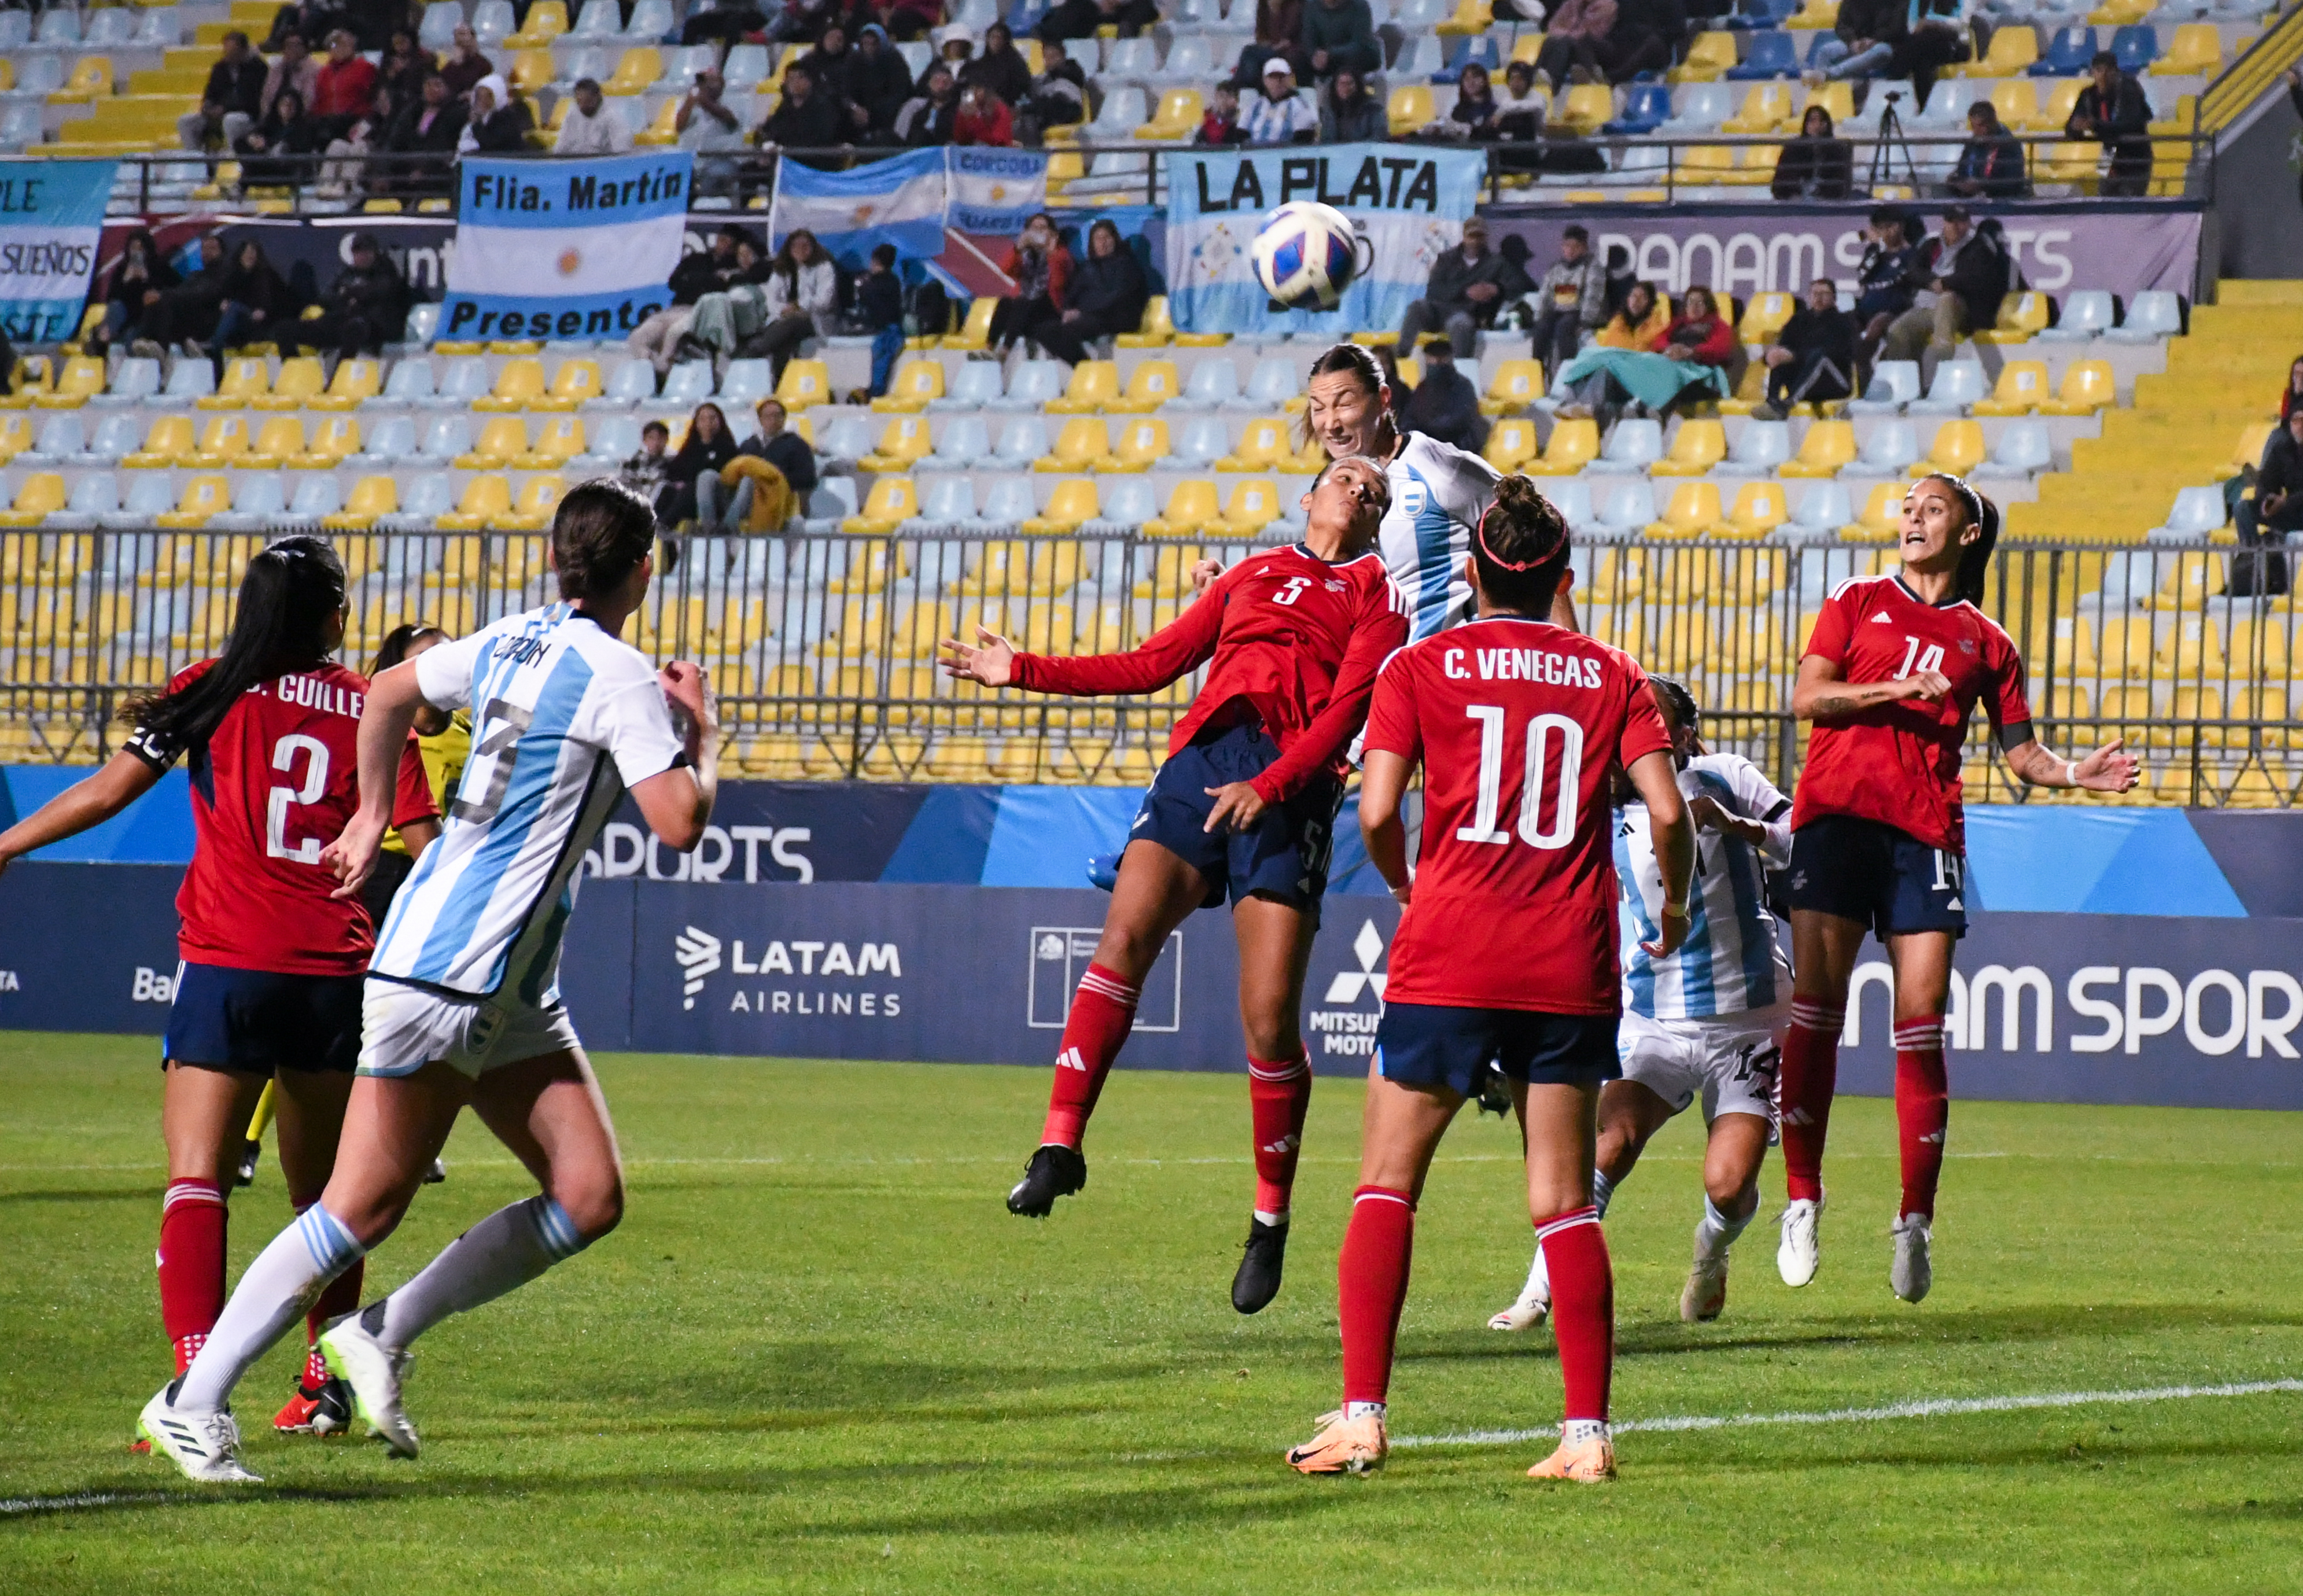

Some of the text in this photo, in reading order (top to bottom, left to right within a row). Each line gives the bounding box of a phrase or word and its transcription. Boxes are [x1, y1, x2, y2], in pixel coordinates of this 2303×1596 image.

[0, 179, 45, 212] LE
[474, 168, 682, 211] Flia. Martín
[1196, 155, 1437, 212] LA PLATA
[1599, 233, 1825, 292] PANAM
[1272, 576, 1311, 605] 5
[1445, 648, 1602, 689] C. VENEGAS
[1893, 635, 1945, 680] 14
[278, 674, 367, 719] GUILLE
[1456, 705, 1584, 850] 10
[267, 734, 330, 865] 2
[732, 939, 901, 978] LATAM
[132, 967, 174, 1002] Ba
[729, 990, 900, 1016] AIRLINES
